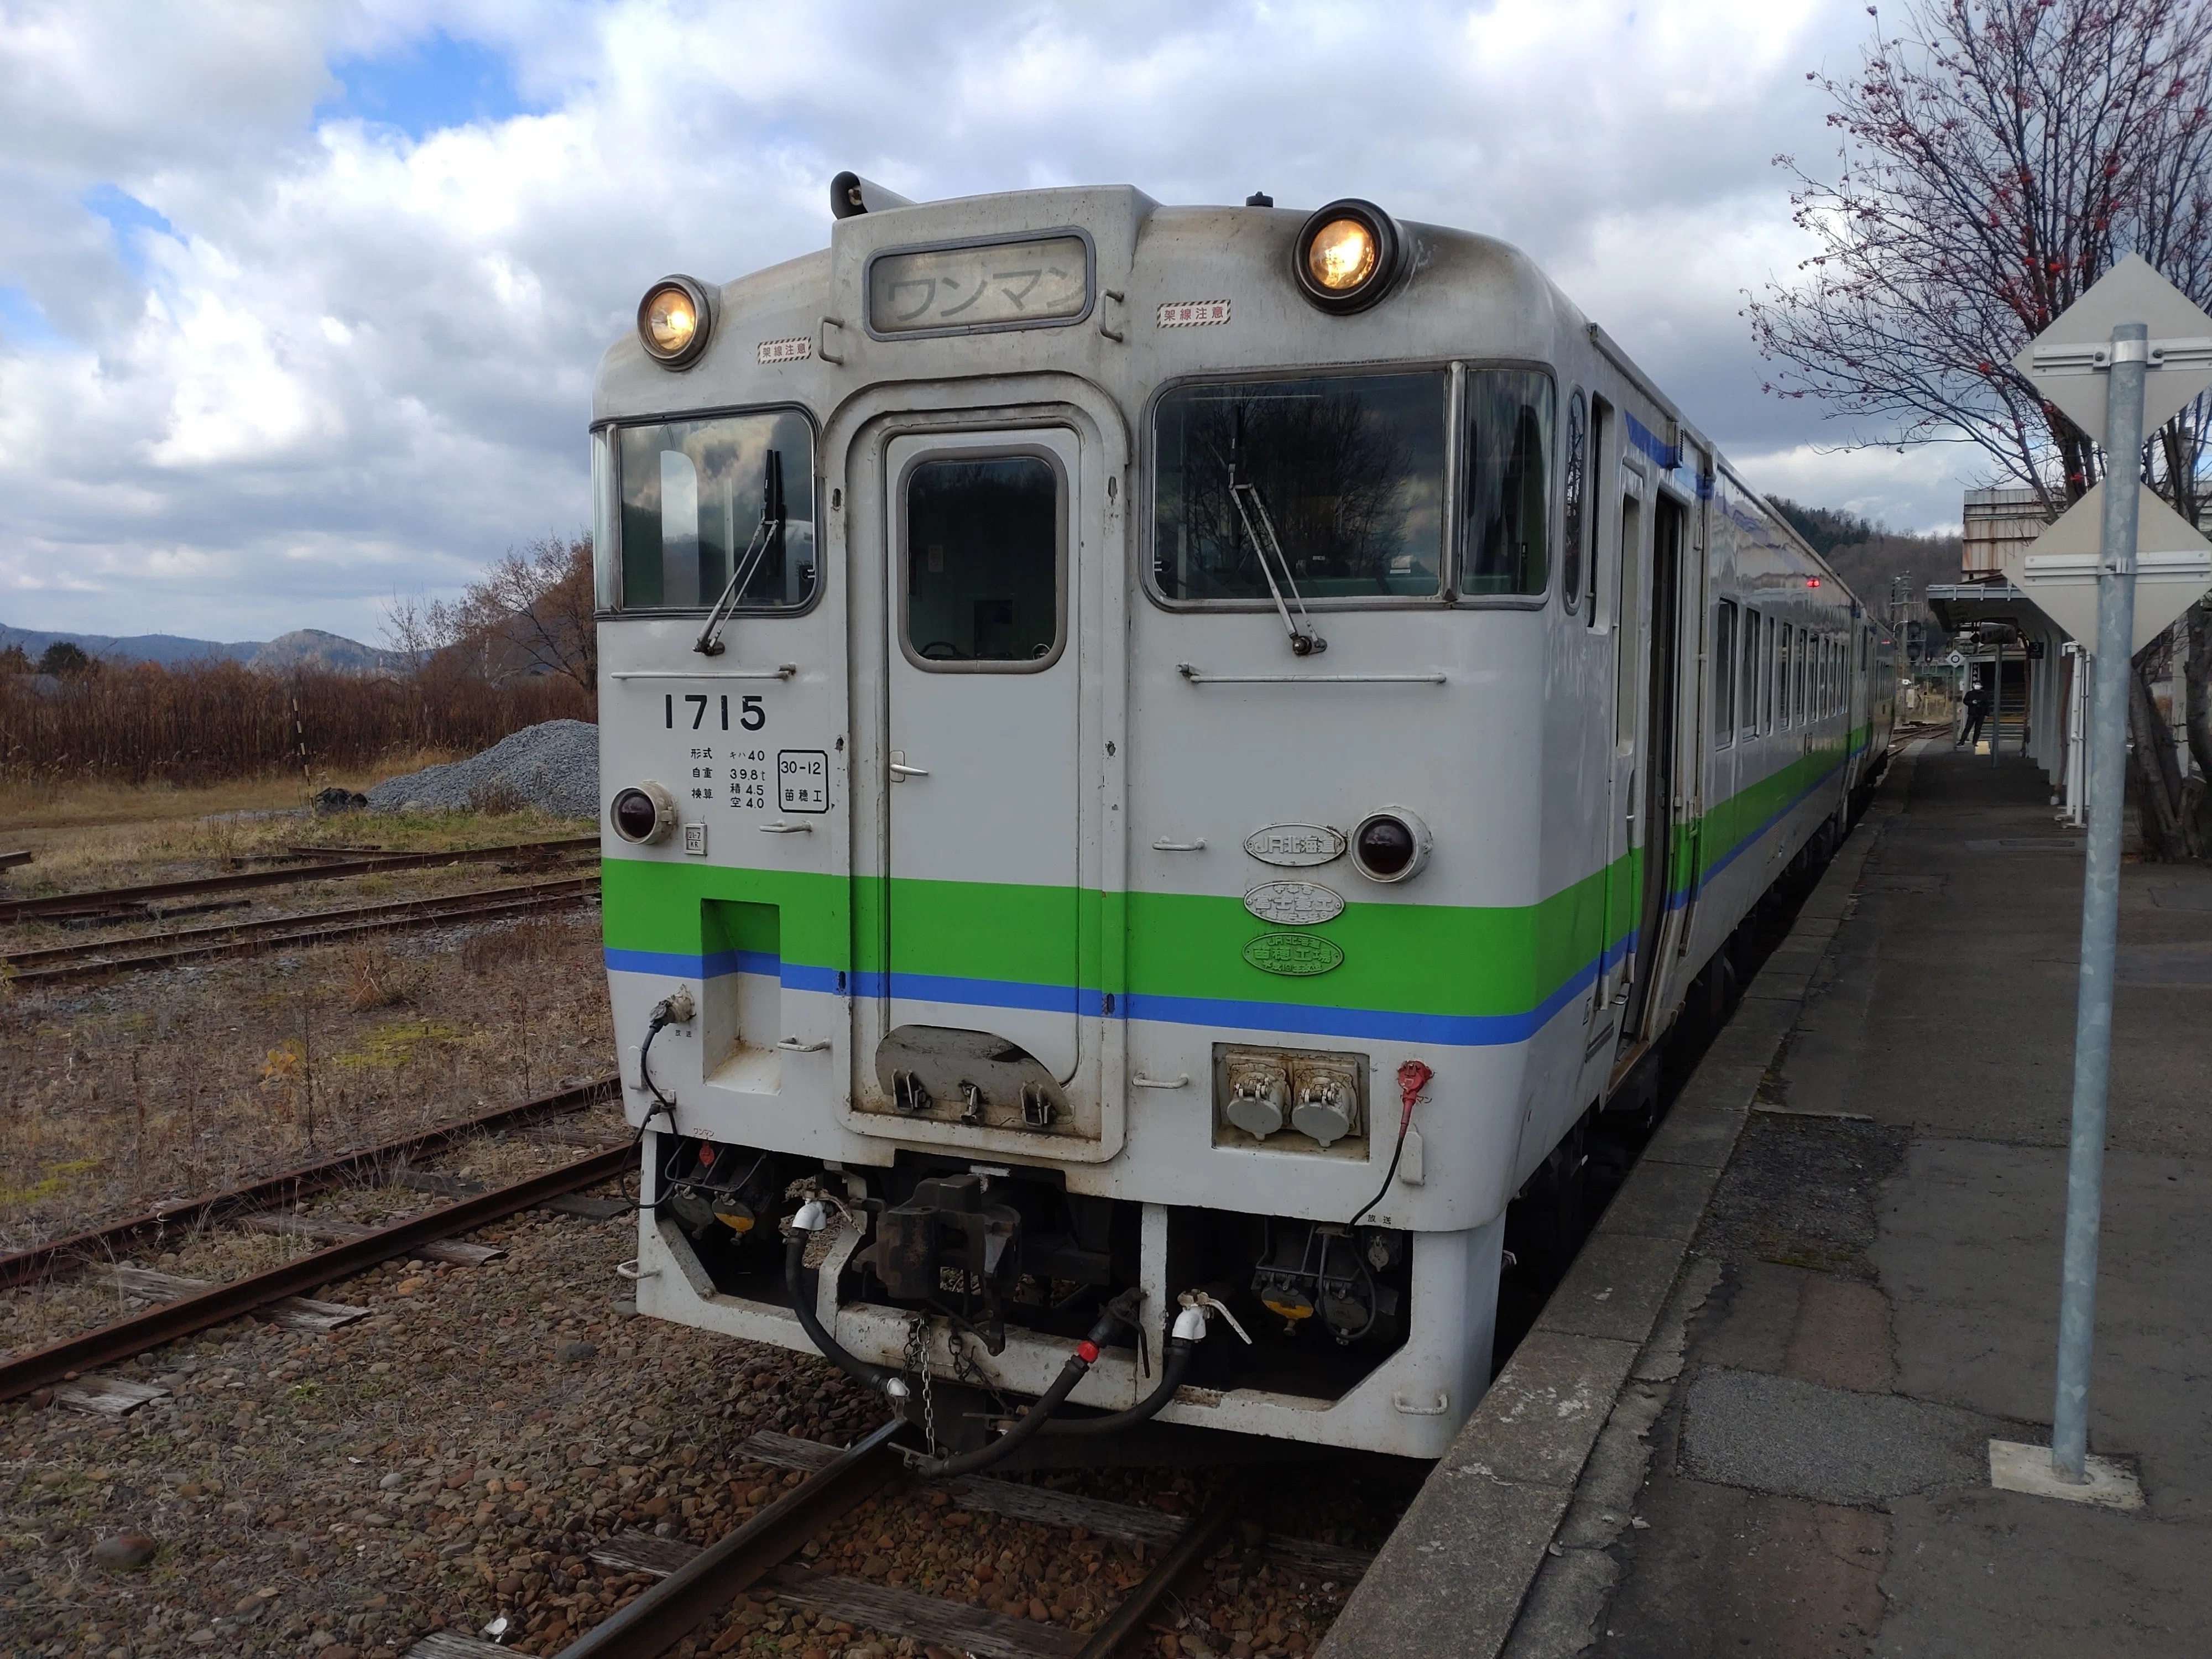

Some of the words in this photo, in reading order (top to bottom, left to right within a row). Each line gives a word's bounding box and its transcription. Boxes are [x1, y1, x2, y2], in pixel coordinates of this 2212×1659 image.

[888, 267, 1086, 321] ワンマン
[1164, 306, 1223, 321] 架線注意
[763, 343, 806, 358] 架線注意
[665, 694, 766, 731] 1715
[691, 747, 713, 759] 形式
[729, 750, 765, 761] キハ40
[692, 767, 713, 779] 自重
[781, 761, 821, 775] 30-12
[691, 788, 713, 799] 換算
[745, 784, 764, 796] 4.5
[785, 789, 822, 802] 苗穂工
[730, 796, 742, 808] 空
[745, 797, 764, 808] 4.0
[1254, 835, 1335, 853] JR北海道
[1254, 894, 1334, 911] 富士重工
[1253, 946, 1332, 963] 苗穂工場
[1400, 1094, 1433, 1104] マン
[1368, 1214, 1391, 1225] 放送
